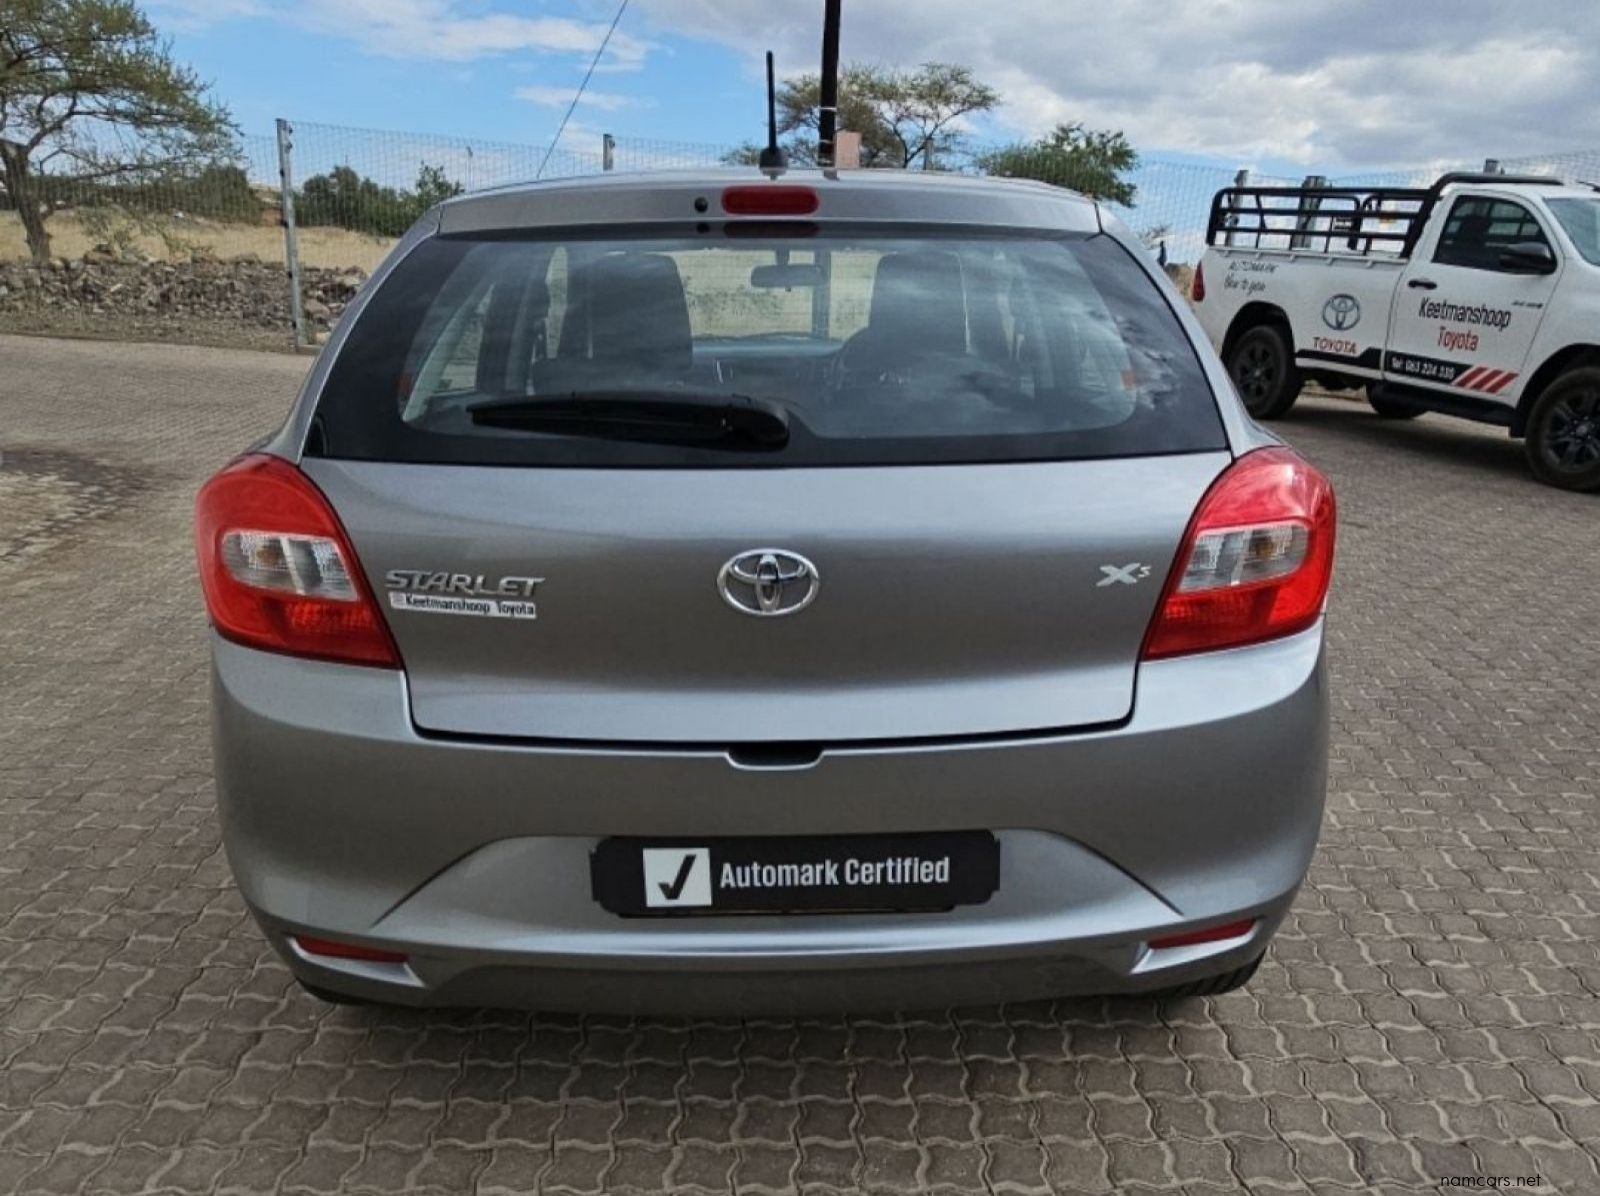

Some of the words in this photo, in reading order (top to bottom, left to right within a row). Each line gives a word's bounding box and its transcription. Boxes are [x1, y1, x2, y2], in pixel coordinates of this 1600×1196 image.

[1418, 297, 1511, 331] Keetmanshoop
[1313, 336, 1357, 354] TOYOTA
[1437, 326, 1480, 351] Toyota
[385, 569, 545, 597] STARLET
[405, 595, 490, 614] Keetmanshoop
[497, 602, 534, 618] Toyota
[720, 860, 839, 888] Automark
[845, 857, 951, 884] Certified
